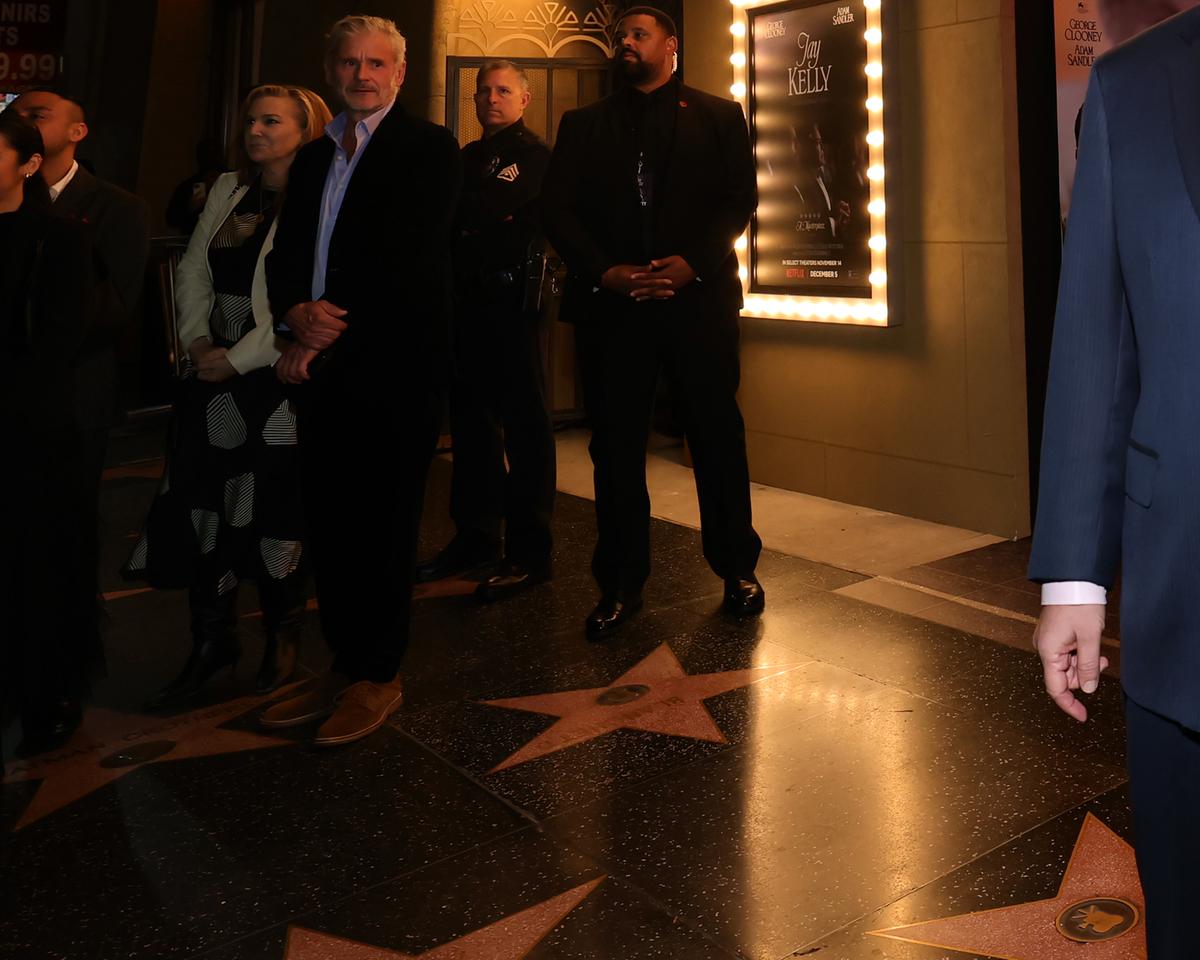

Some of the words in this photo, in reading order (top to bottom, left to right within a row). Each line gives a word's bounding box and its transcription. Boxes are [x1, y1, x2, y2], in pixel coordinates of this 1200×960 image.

[832, 13, 855, 26] SANDLER
[1070, 18, 1097, 30] GEORGE
[1064, 28, 1102, 42] CLOONEY
[796, 32, 821, 69] Jay
[1074, 44, 1094, 55] ADAM
[788, 65, 832, 96] KELLY
[810, 270, 834, 278] DECEMBER
